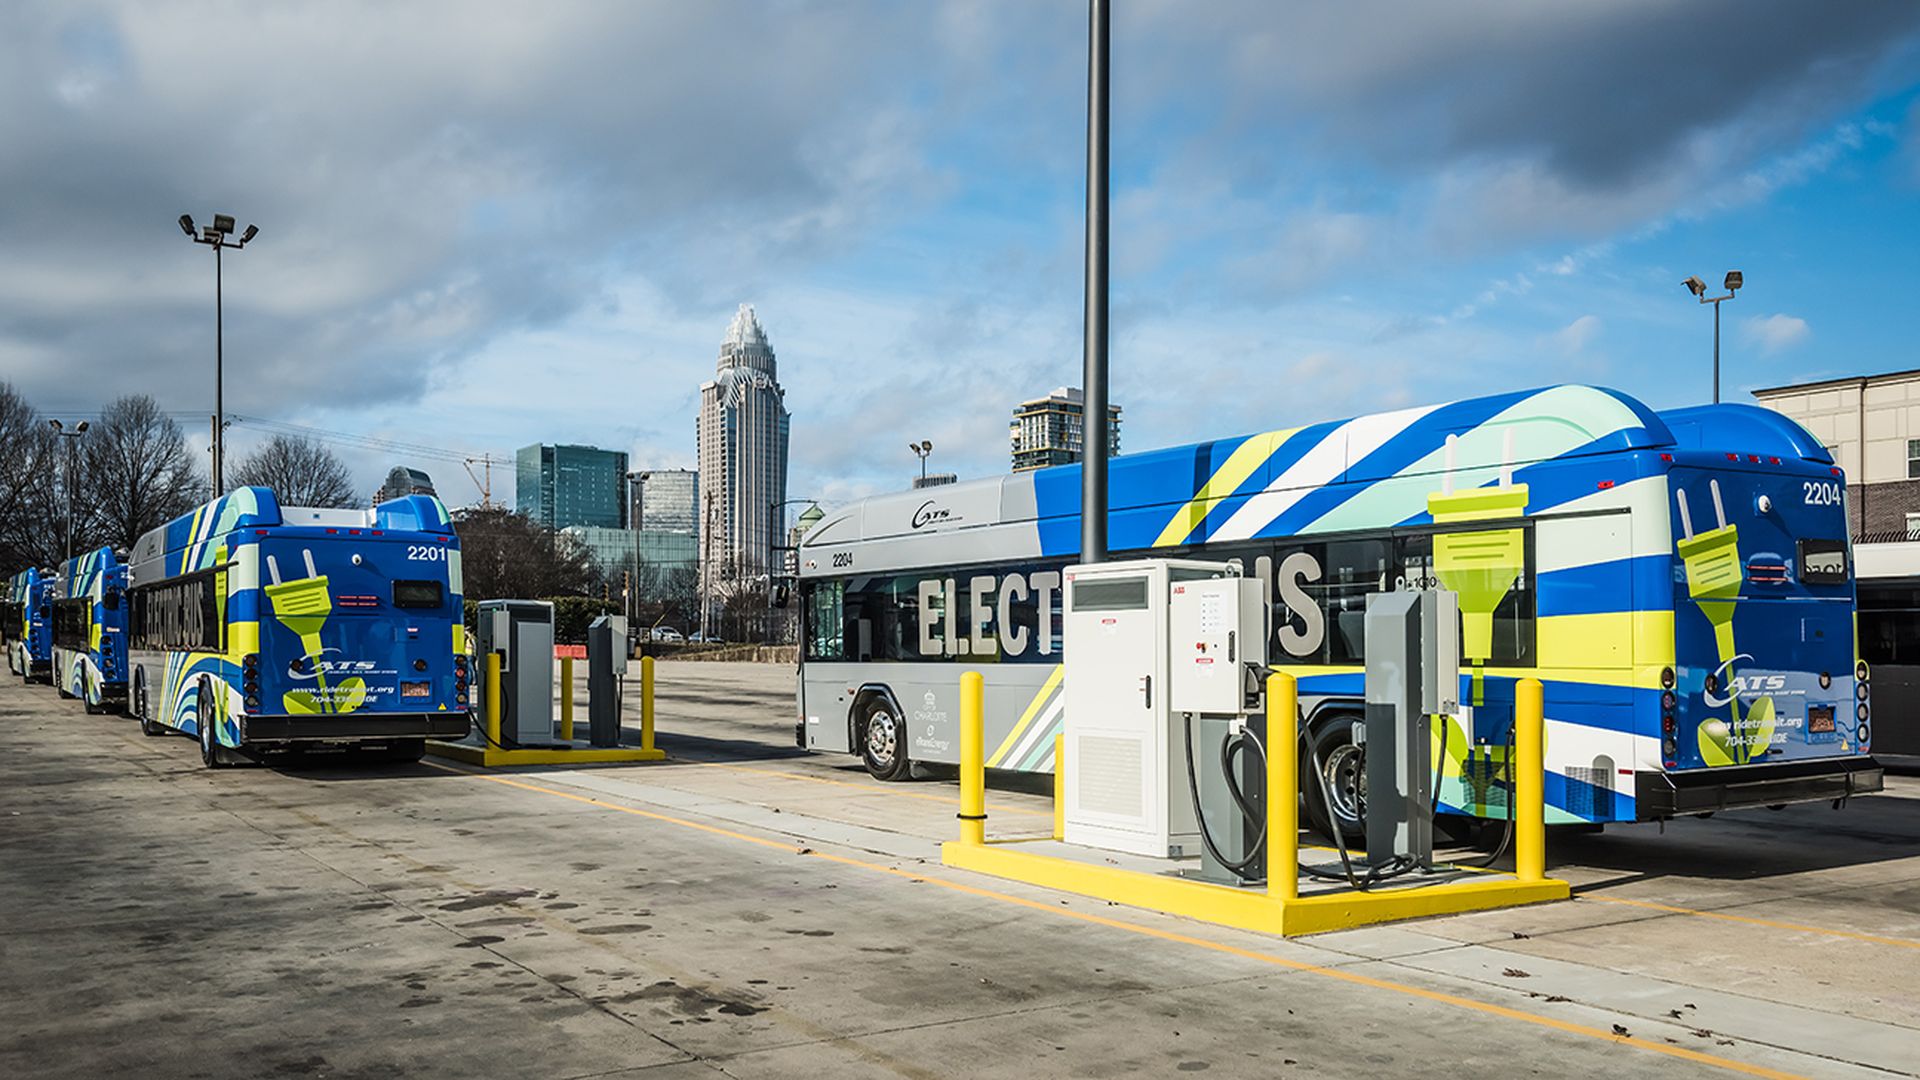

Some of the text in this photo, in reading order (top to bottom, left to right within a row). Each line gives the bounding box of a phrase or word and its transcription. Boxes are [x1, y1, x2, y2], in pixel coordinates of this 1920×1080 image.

[1803, 482, 1841, 505] 2204
[407, 546, 445, 561] 2201
[832, 552, 853, 567] 2204
[183, 580, 204, 647] BUS
[918, 571, 1060, 656] ELECT
[291, 685, 395, 694] www.ridetrit.org
